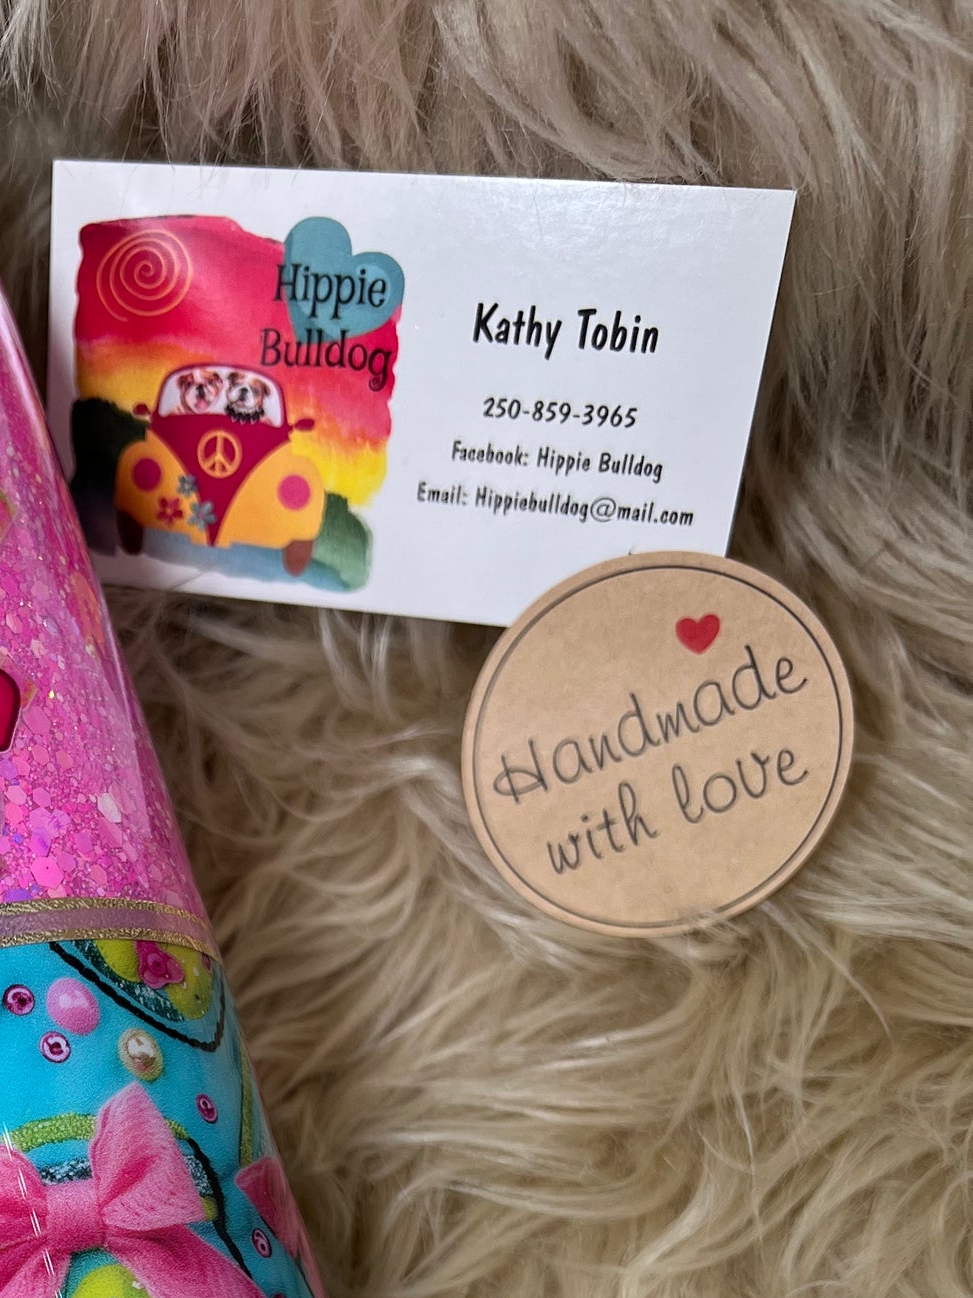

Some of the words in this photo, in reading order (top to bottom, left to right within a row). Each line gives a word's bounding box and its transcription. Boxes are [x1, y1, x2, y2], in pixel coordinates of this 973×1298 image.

[274, 263, 387, 319] Hippie
[260, 327, 392, 390] Bulldog
[473, 302, 561, 359] Kathy
[577, 308, 658, 352] Tobin
[483, 397, 637, 426] 250-859-3965
[451, 440, 528, 465] Facebook:
[536, 446, 590, 475] Hippie
[598, 452, 663, 482] Bulldog
[416, 481, 467, 504] Email:
[475, 486, 694, 525] Hippiebulldog@mail.com
[493, 645, 807, 803] Handmade
[546, 782, 657, 874] with
[671, 750, 807, 822] love
